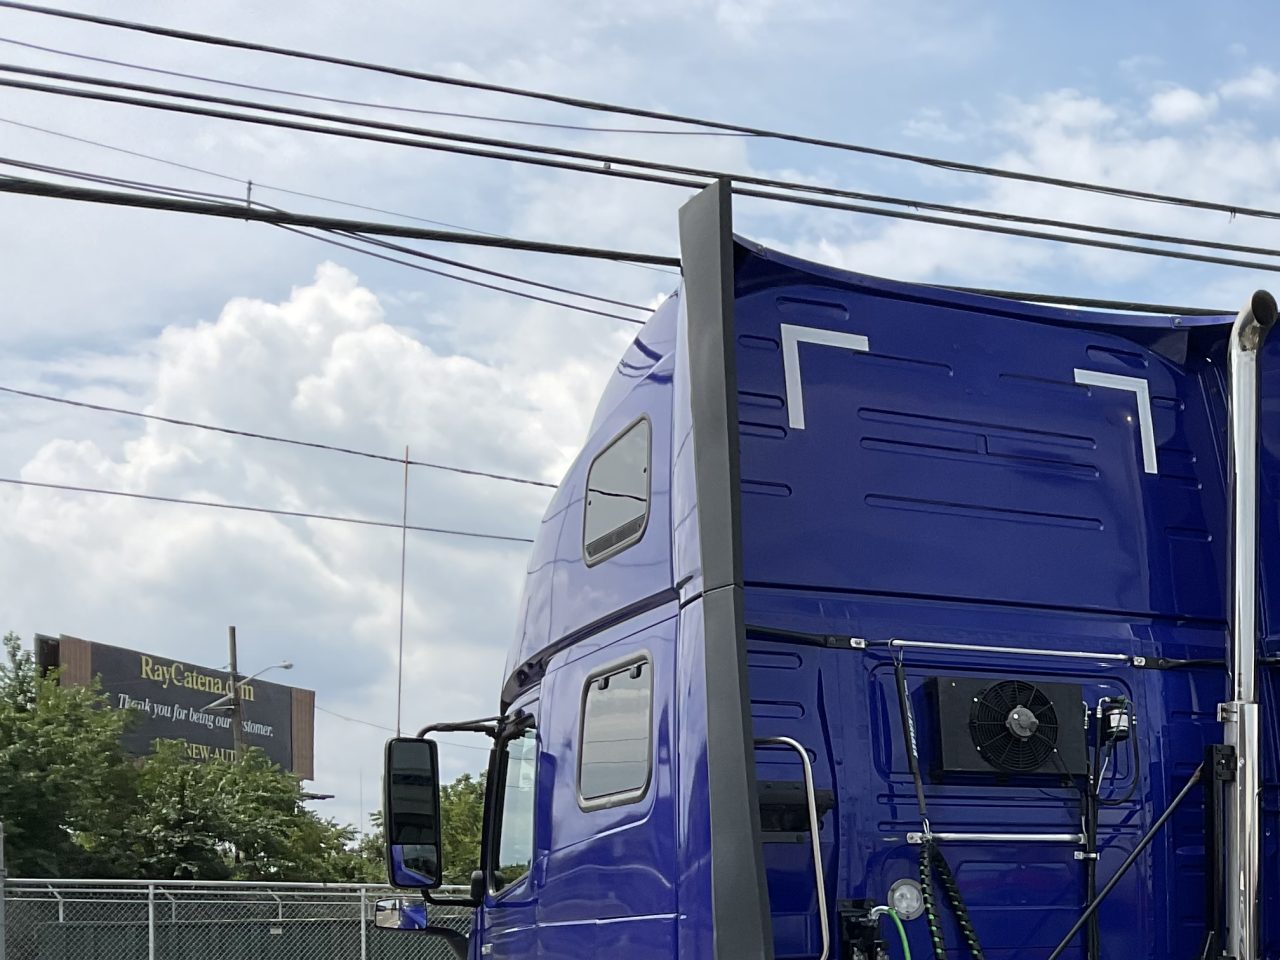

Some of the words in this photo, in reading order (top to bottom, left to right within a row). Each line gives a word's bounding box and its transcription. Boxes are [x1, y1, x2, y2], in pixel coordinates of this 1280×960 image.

[140, 655, 254, 701] RayCatena.cm
[152, 703, 172, 719] you
[172, 703, 188, 722] for
[189, 708, 214, 729] being
[215, 716, 232, 729] our
